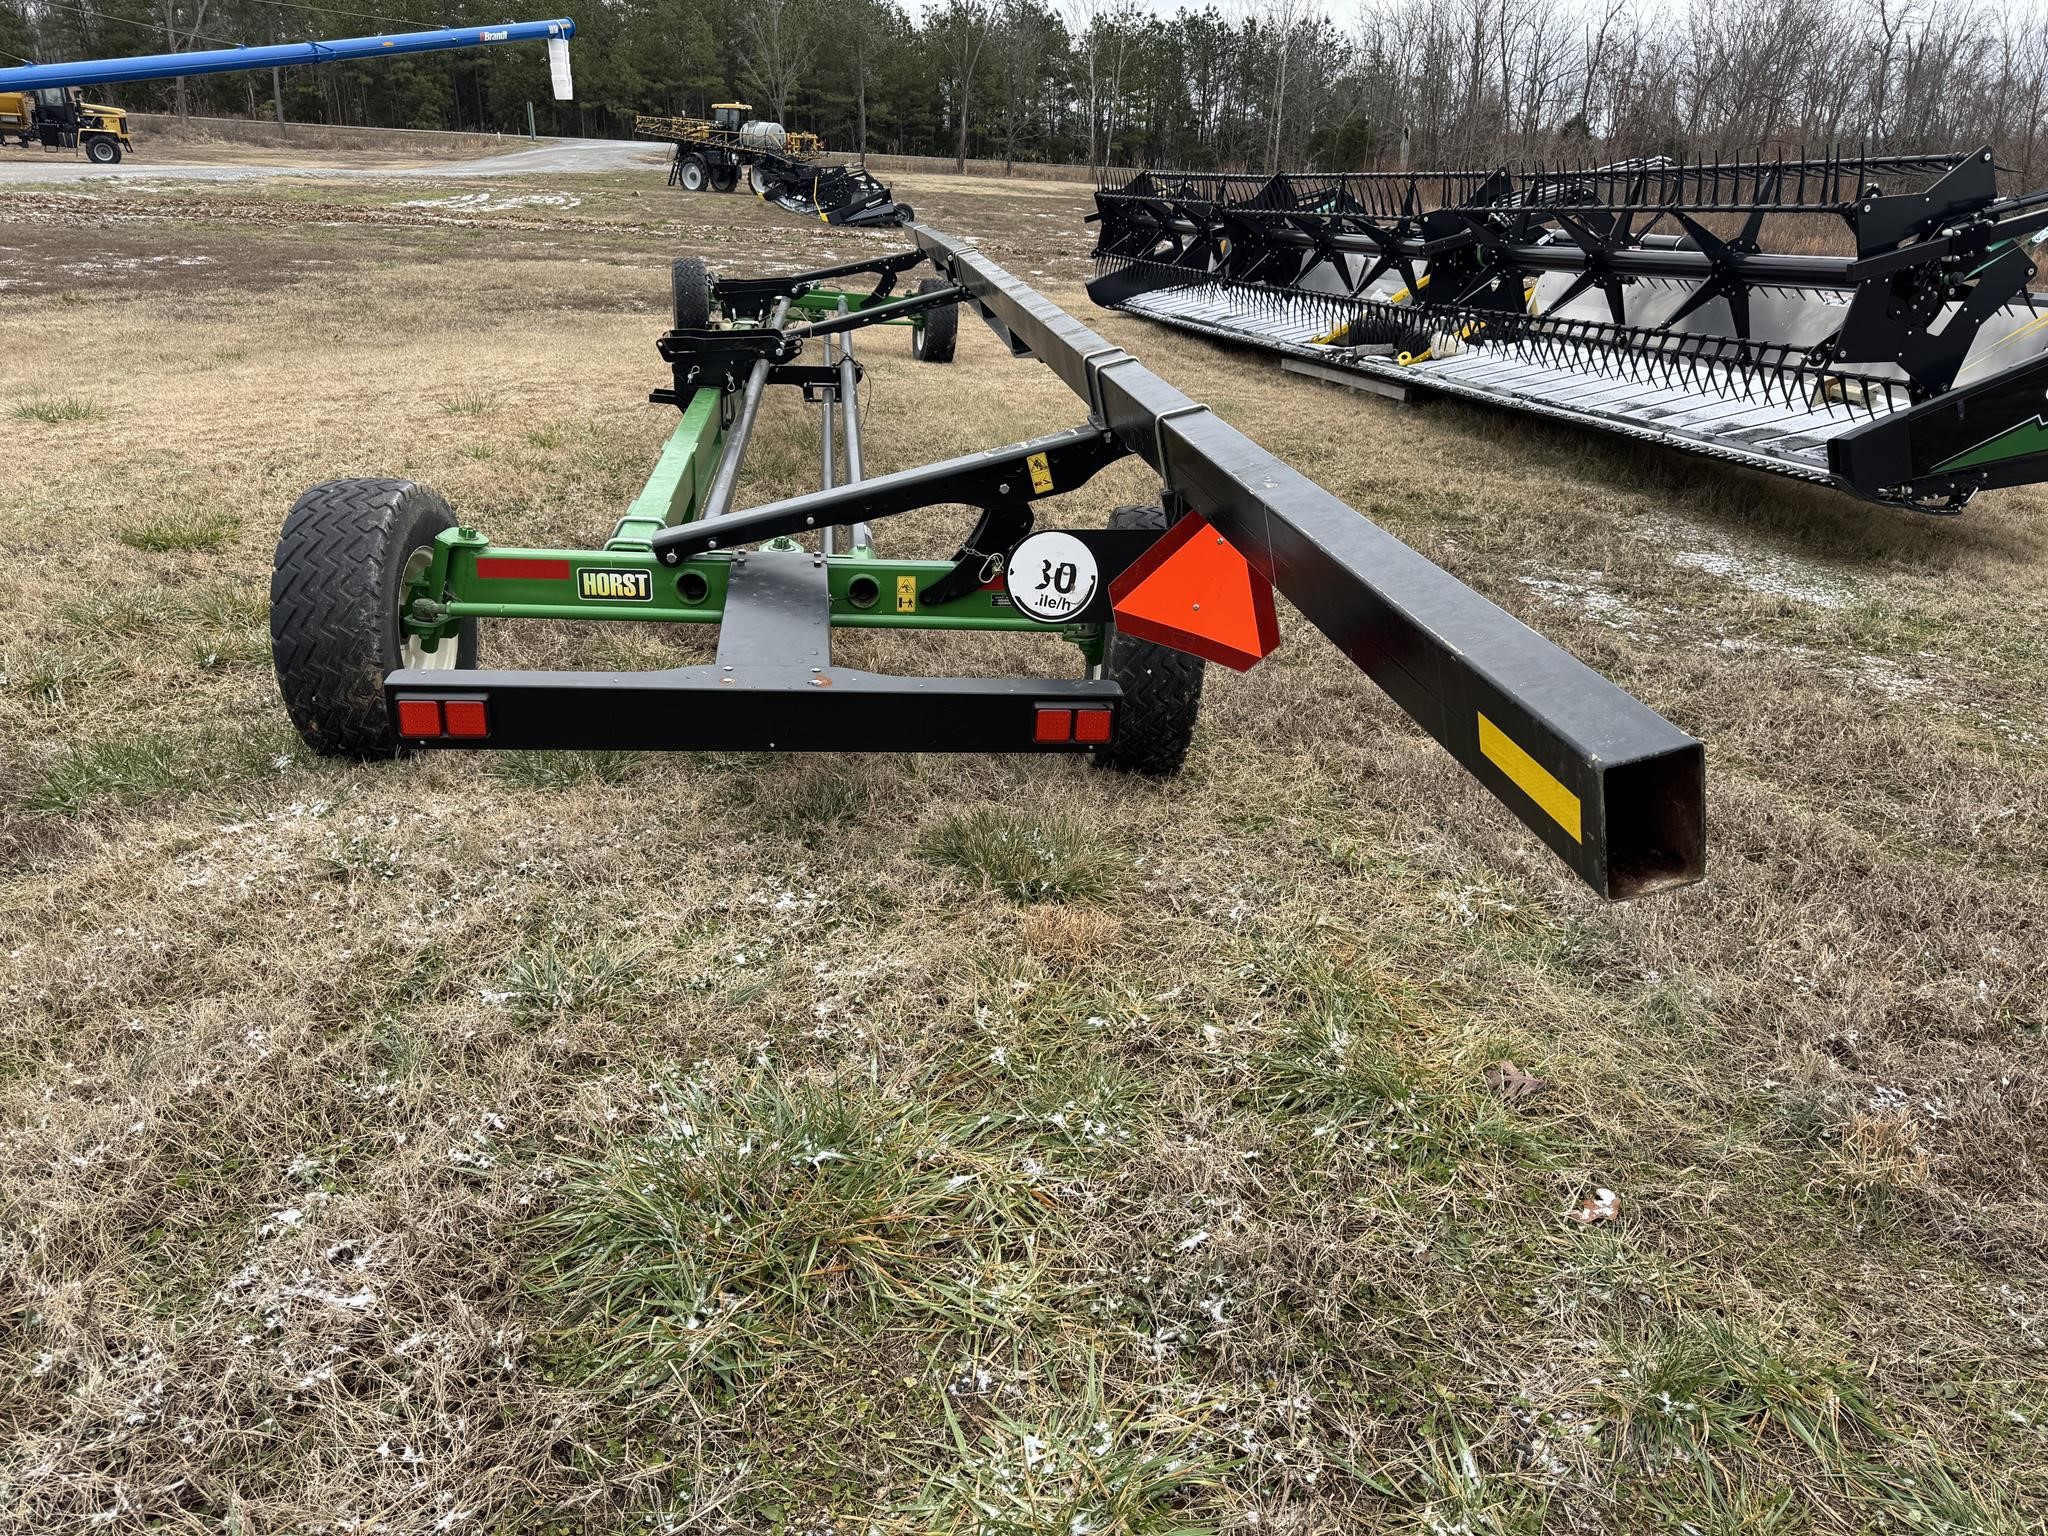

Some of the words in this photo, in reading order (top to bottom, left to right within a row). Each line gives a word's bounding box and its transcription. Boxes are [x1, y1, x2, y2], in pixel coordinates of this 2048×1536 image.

[484, 30, 508, 41] Brandt
[582, 572, 648, 597] HORST
[1034, 594, 1071, 611] ile/h
